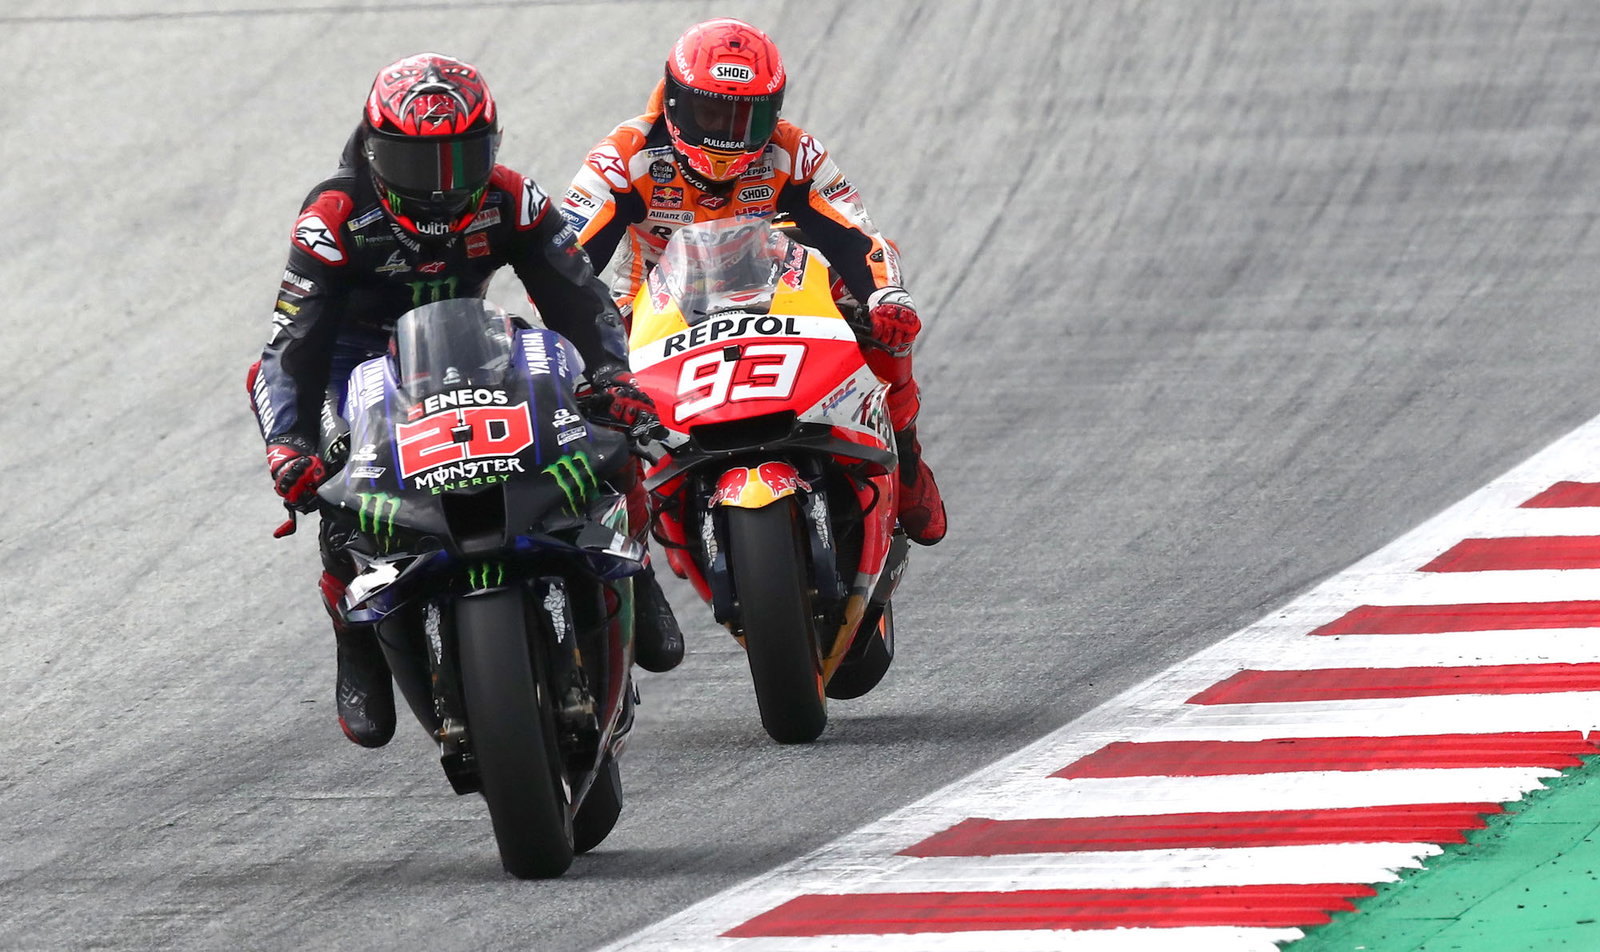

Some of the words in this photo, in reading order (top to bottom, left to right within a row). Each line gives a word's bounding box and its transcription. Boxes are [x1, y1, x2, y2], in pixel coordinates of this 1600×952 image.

[717, 66, 749, 80] SHOEI
[694, 88, 719, 99] GIVES
[722, 93, 741, 101] YOU
[703, 137, 745, 149] PULL&BEAR
[677, 162, 708, 192] REPSOL
[742, 187, 770, 200] SHOEI
[649, 210, 680, 220] Allianz
[390, 223, 421, 253] YAMAHA
[663, 316, 801, 358] REPSOL
[521, 332, 550, 376] YAMAHA
[673, 343, 806, 423] 93
[253, 369, 275, 440] YAMAHA
[424, 388, 509, 414] ENEOS
[396, 401, 534, 480] 20
[414, 457, 526, 491] MONSTER
[431, 474, 511, 496] ENERGY
